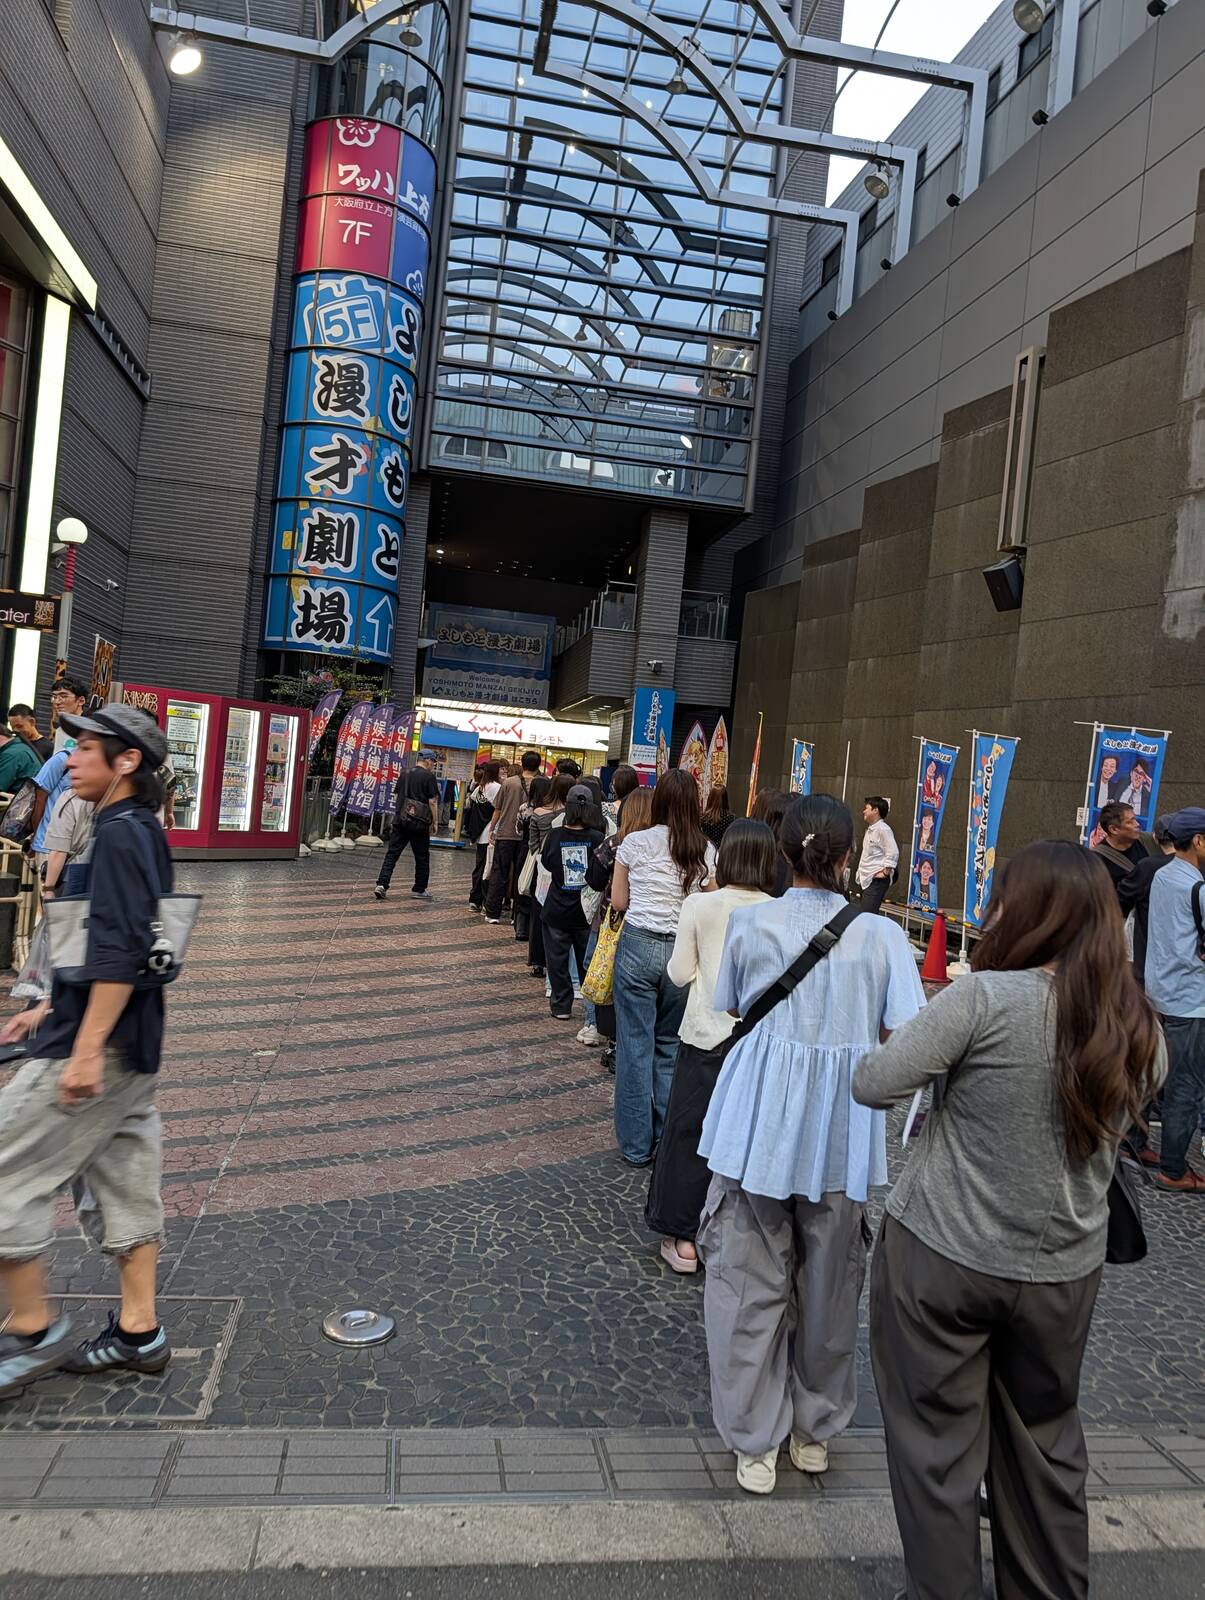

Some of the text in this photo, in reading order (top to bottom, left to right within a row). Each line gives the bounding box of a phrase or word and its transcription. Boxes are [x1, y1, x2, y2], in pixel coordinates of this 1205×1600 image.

[338, 219, 374, 245] 7F
[322, 302, 373, 345] 5F
[374, 306, 419, 577] よしもと
[295, 358, 366, 644] 漫才劇場
[438, 627, 542, 654] よしもと漫才劇場
[475, 682, 506, 693] MANZAI
[528, 733, 564, 746] ヨシモト
[355, 718, 386, 810] 娱乐博物馆
